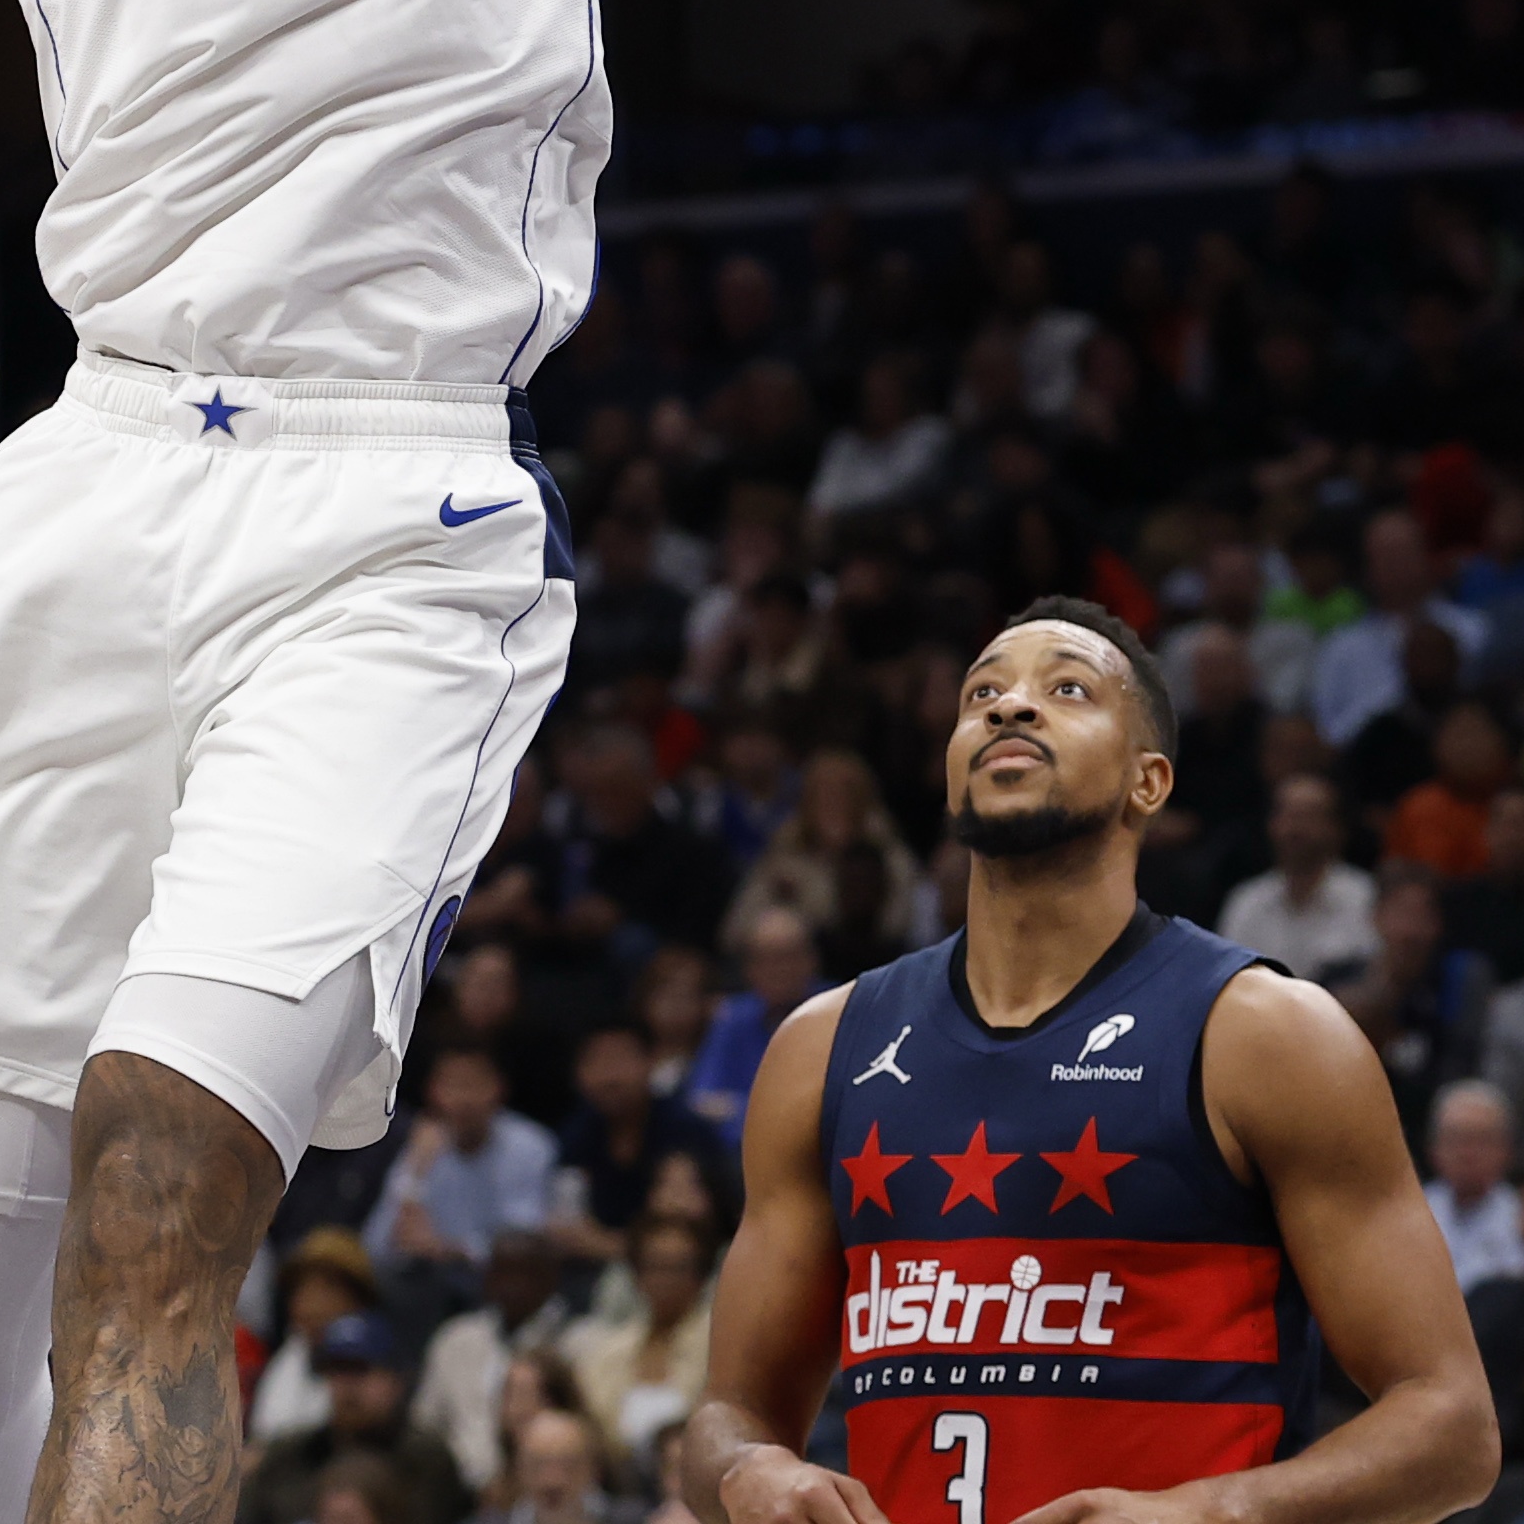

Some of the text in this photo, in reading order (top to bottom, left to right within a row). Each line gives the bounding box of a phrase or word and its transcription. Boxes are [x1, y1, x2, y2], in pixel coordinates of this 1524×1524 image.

[1050, 1063, 1144, 1082] Robinhood
[895, 1259, 941, 1284] THE
[847, 1248, 1125, 1354] district
[854, 1363, 1100, 1395] OF COLUMBIA
[931, 1410, 990, 1524] 3
